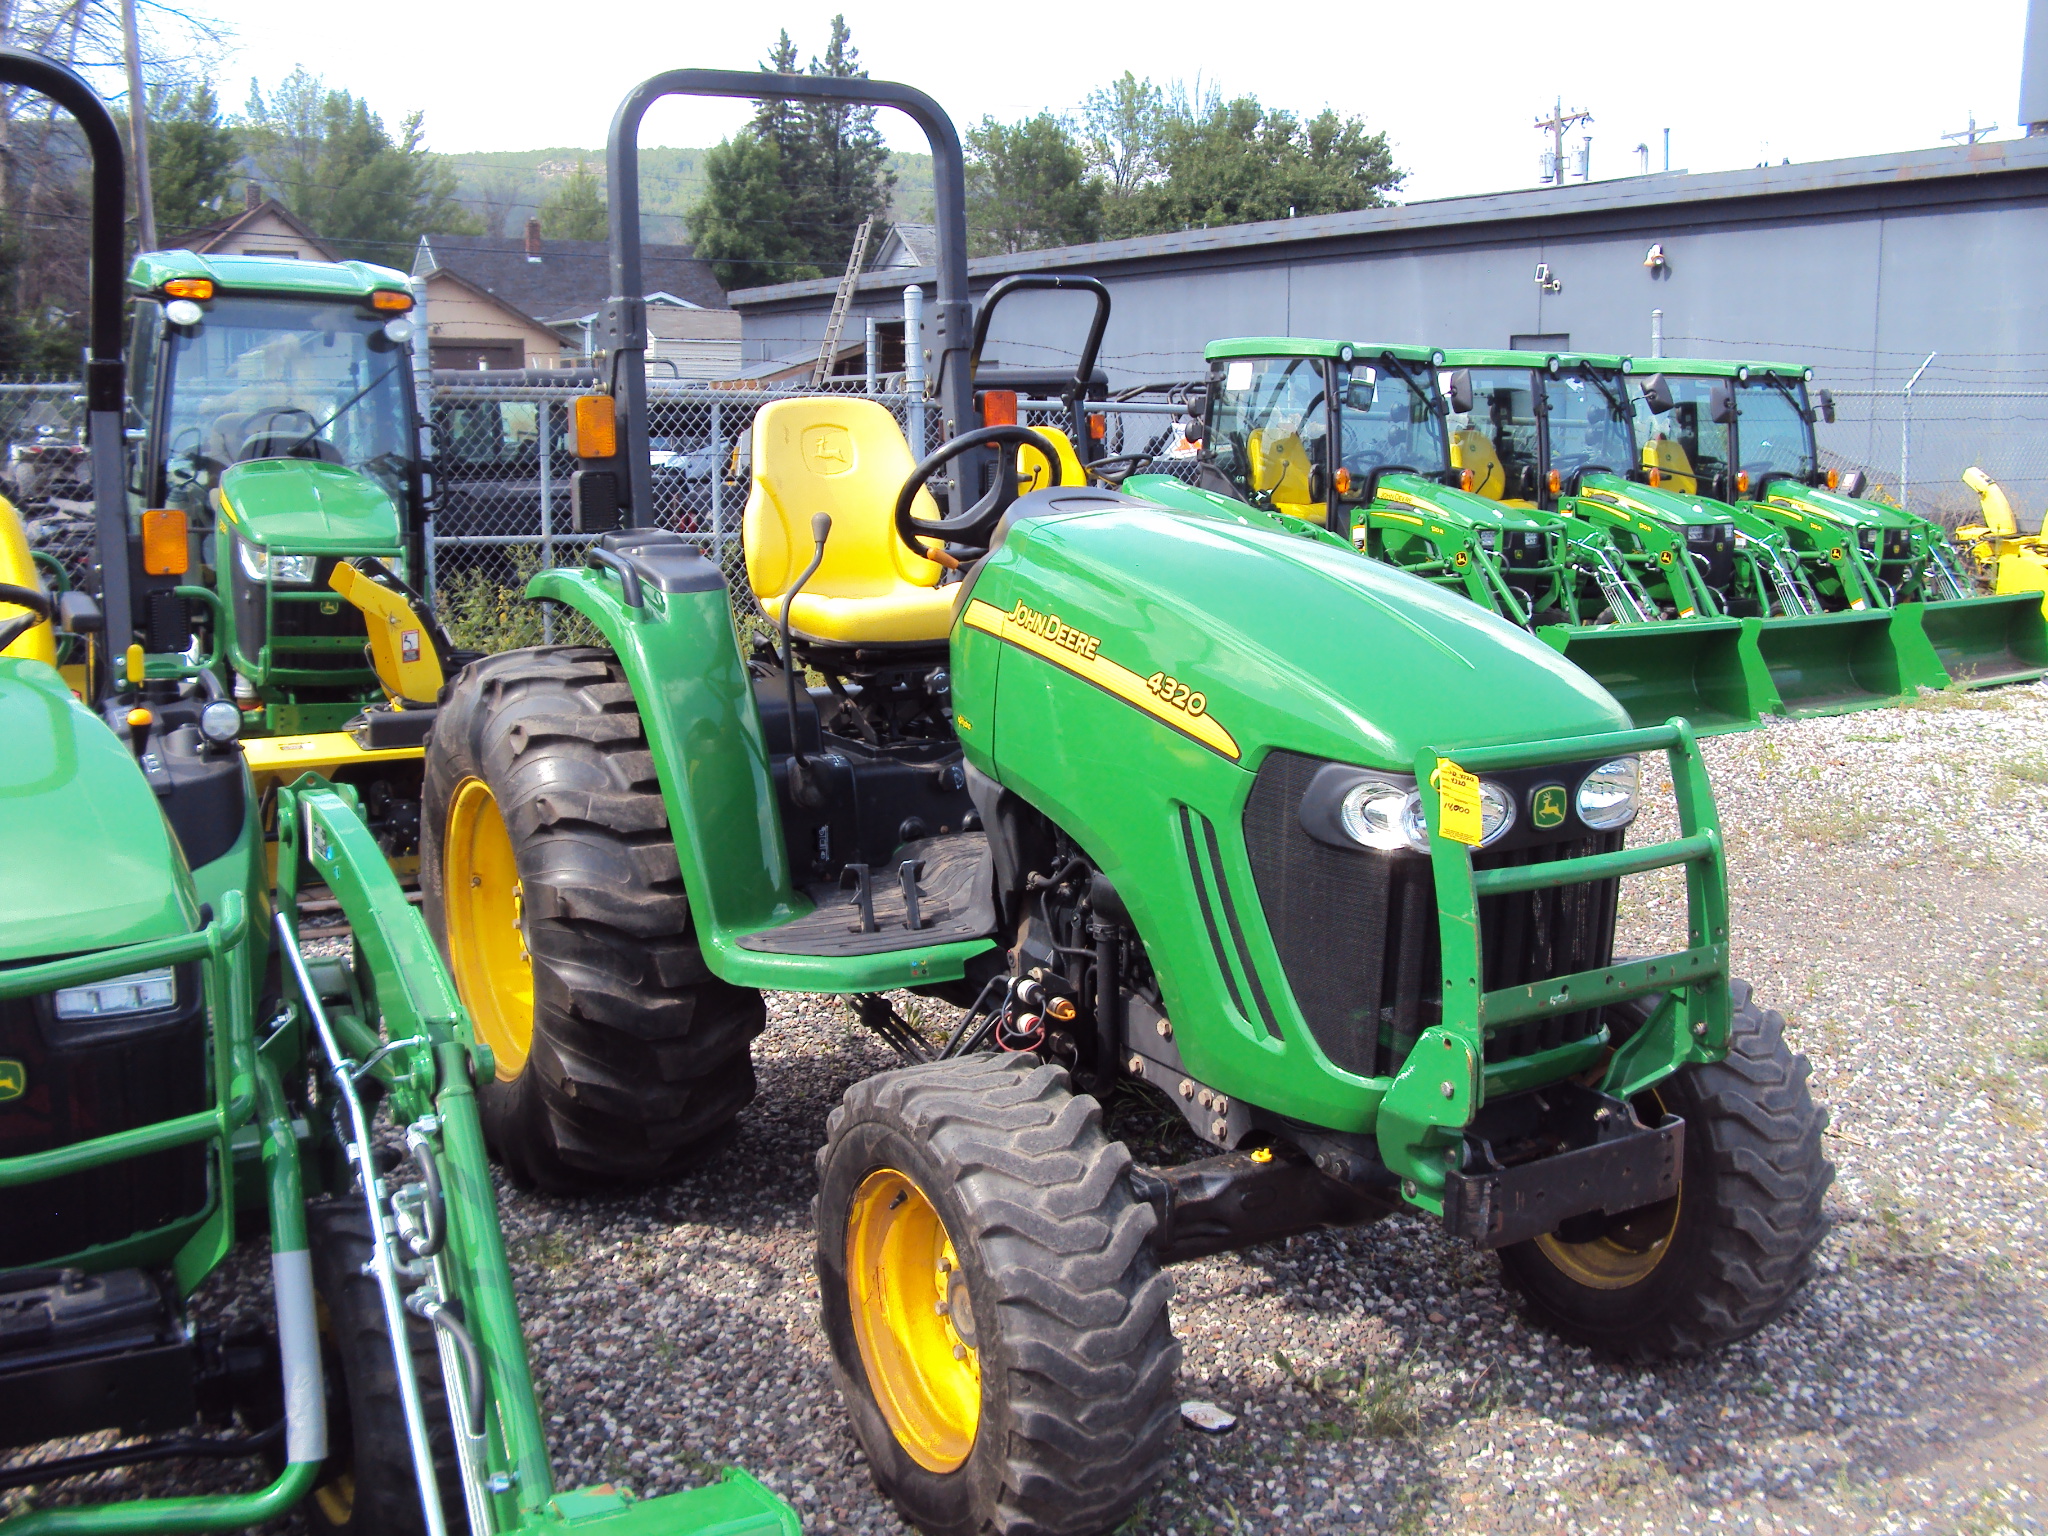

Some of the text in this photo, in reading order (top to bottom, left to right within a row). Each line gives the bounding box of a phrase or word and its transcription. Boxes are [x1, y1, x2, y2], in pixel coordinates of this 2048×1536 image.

[1007, 599, 1101, 660] JOHN DEERE
[1146, 671, 1207, 716] 4320
